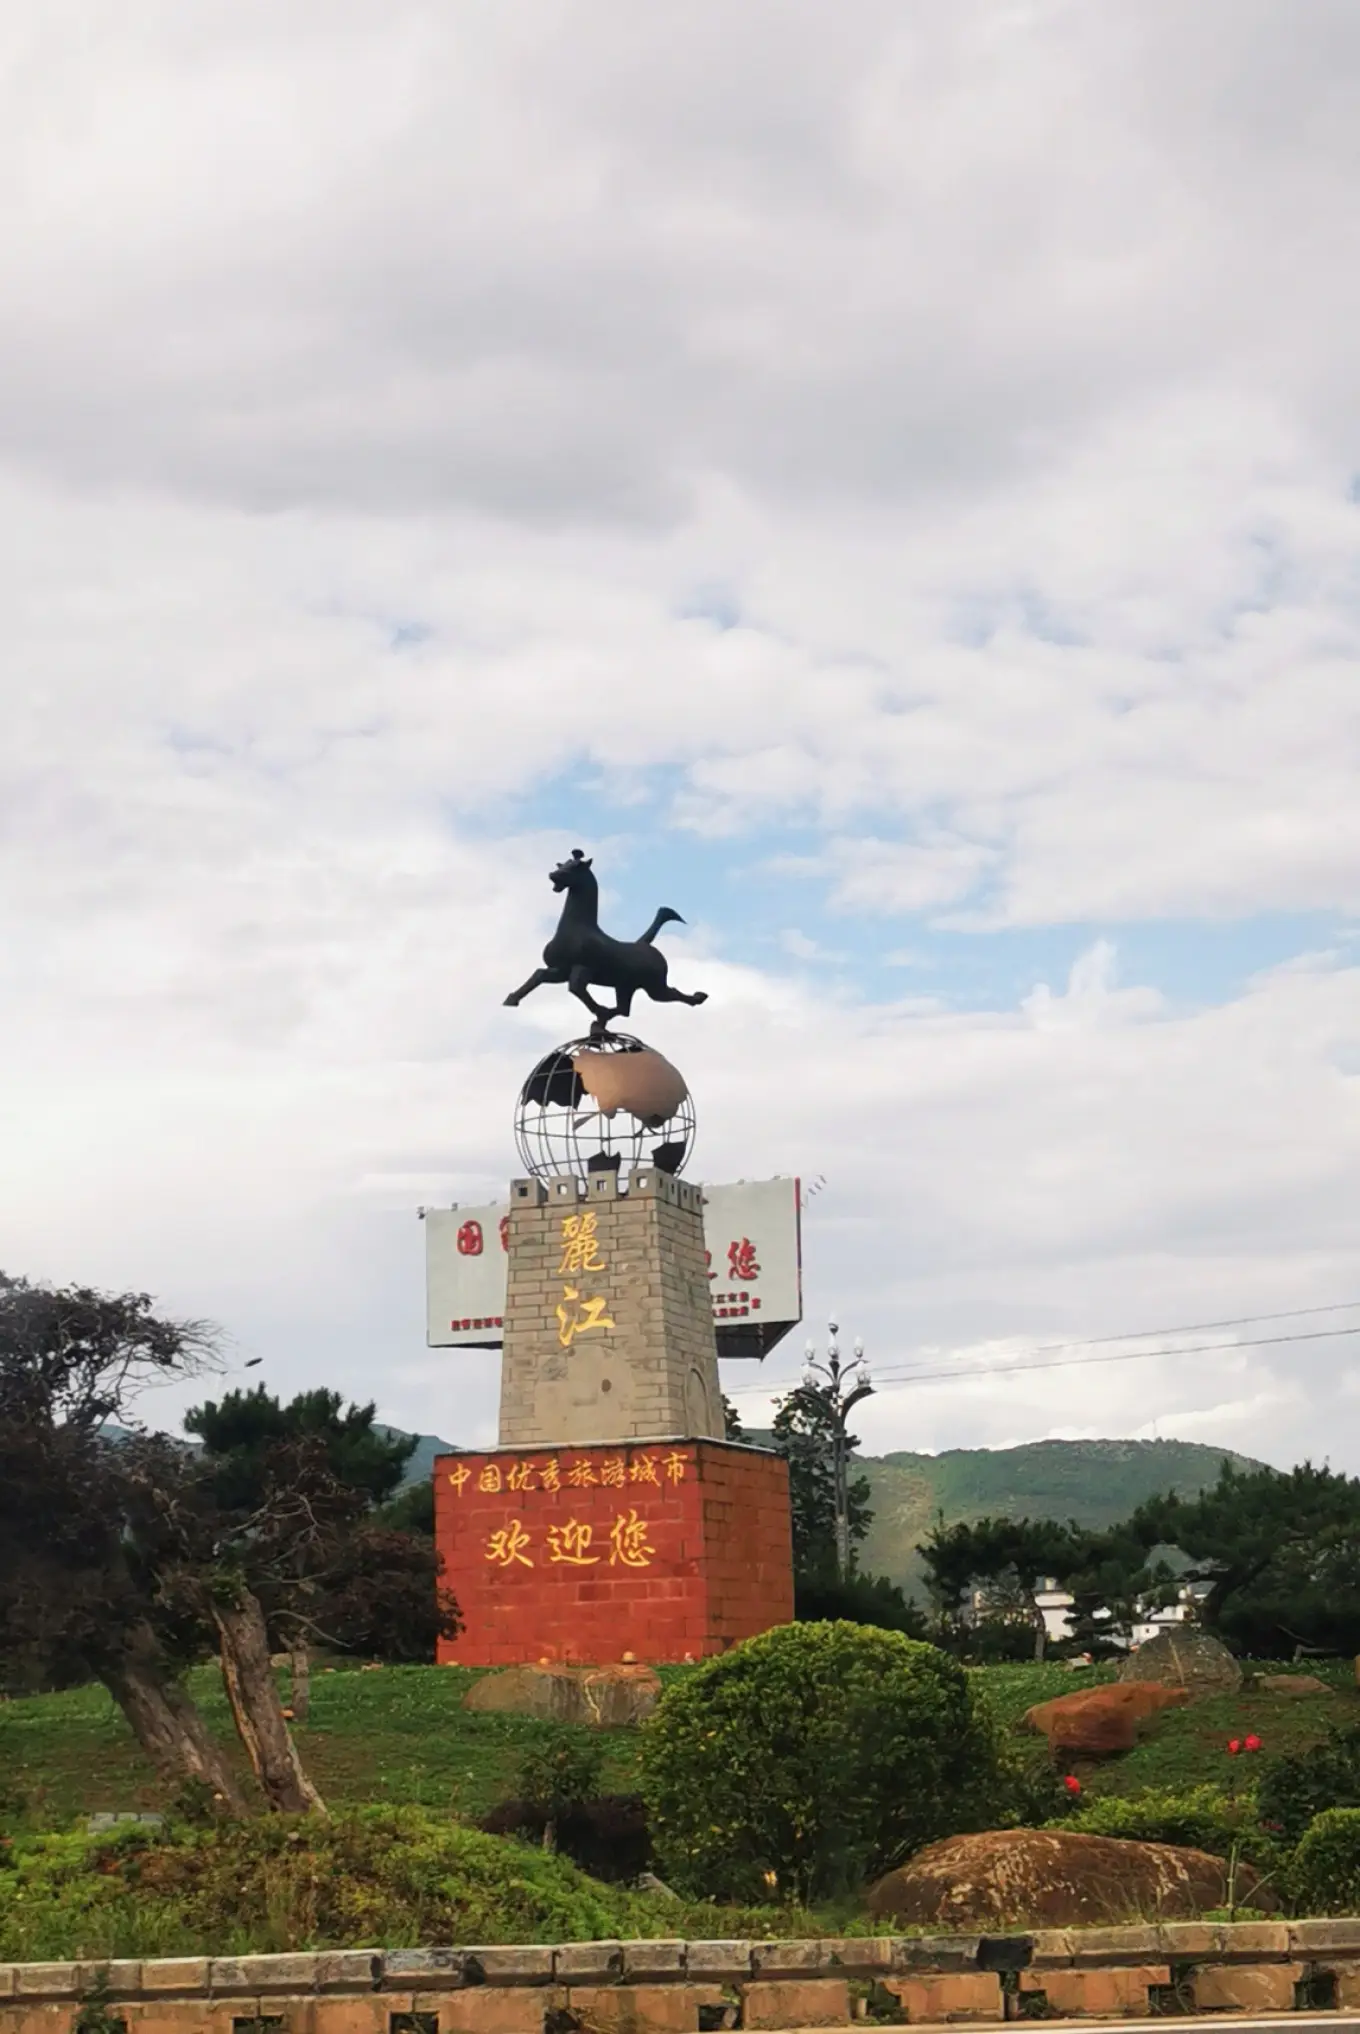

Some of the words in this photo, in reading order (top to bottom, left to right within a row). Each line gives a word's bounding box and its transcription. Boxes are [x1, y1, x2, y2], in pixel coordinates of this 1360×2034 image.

[555, 1211, 615, 1347] 麗江
[448, 1452, 688, 1497] 中国优秀旅游城市
[485, 1509, 656, 1568] 欢迎您
